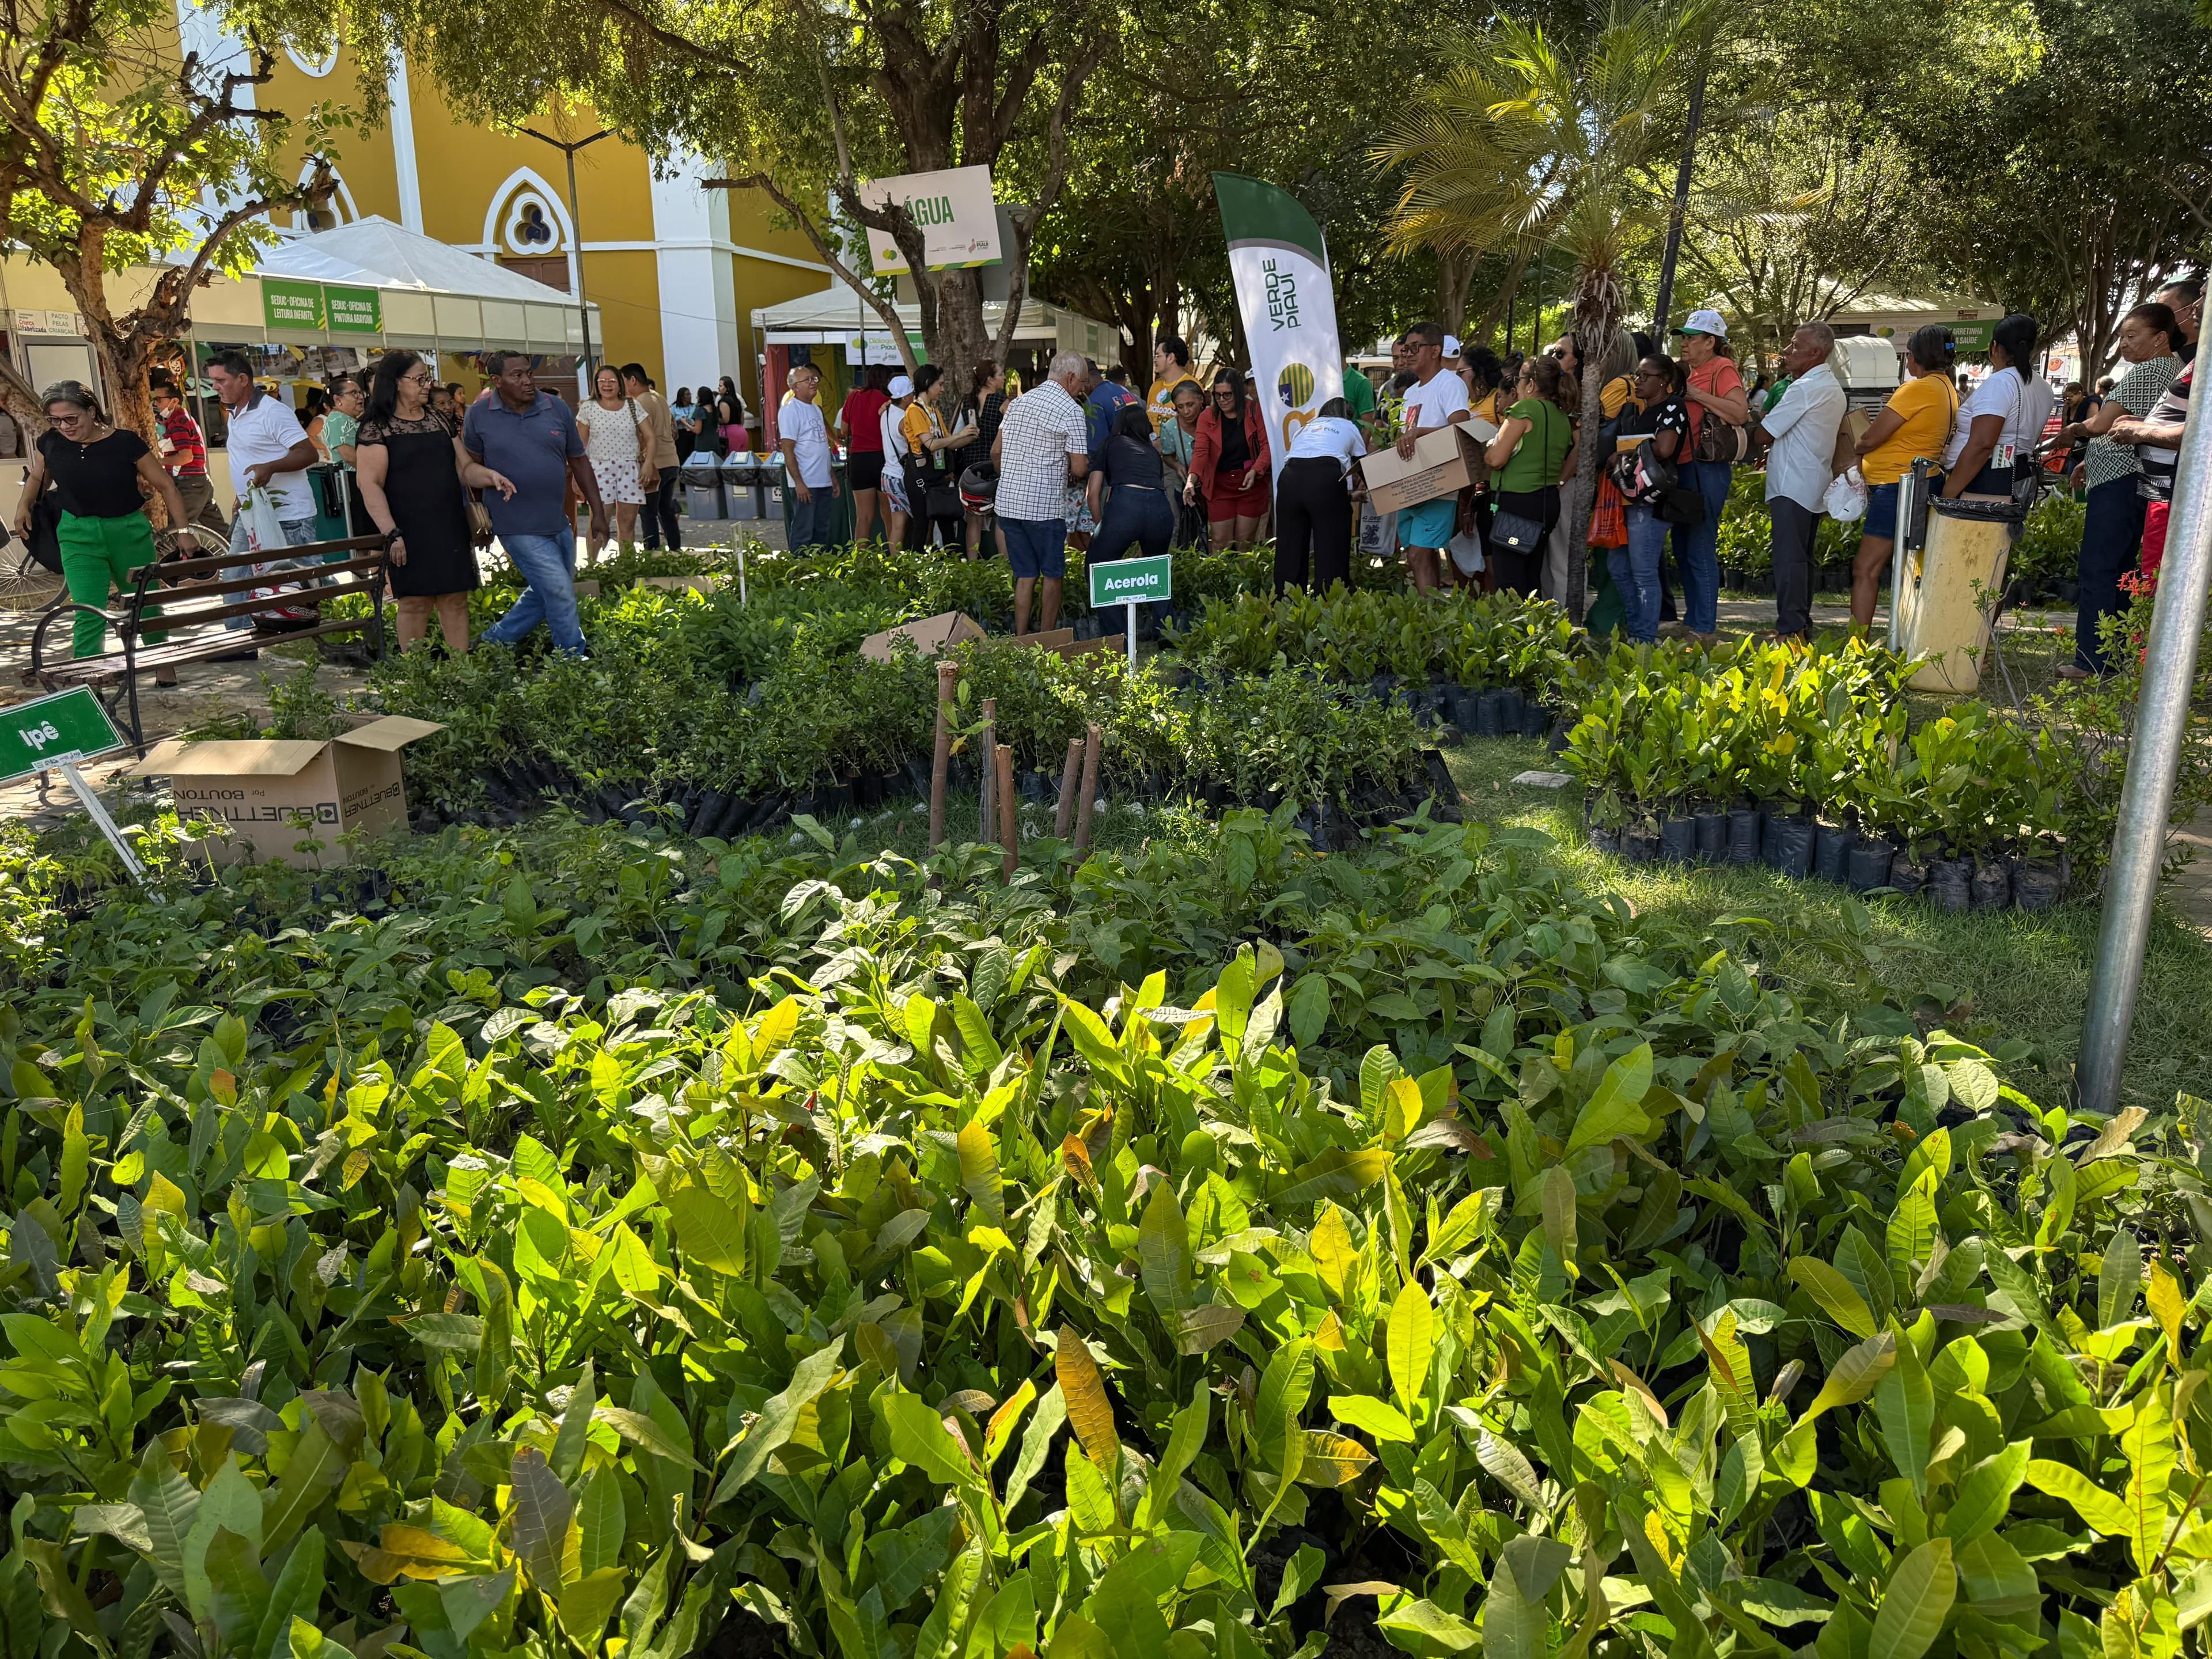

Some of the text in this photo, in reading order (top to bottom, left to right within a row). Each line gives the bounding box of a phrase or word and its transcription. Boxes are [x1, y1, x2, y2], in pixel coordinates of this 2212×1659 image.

[271, 294, 287, 305] SEDUC
[289, 296, 308, 308] OFICINA
[308, 298, 315, 308] DE
[1262, 258, 1285, 332] VERDE
[331, 300, 347, 310] SEDUC
[349, 301, 366, 312] OFICINA
[367, 302, 372, 312] DE
[274, 308, 315, 321] LEITURA INFANTIL
[334, 313, 354, 323] PINTURA
[1104, 573, 1158, 590] Acerola
[18, 720, 59, 751] Ipê
[174, 789, 244, 800] BOUTON
[343, 787, 368, 805] BOUTON
[346, 785, 393, 818] BUETTNER
